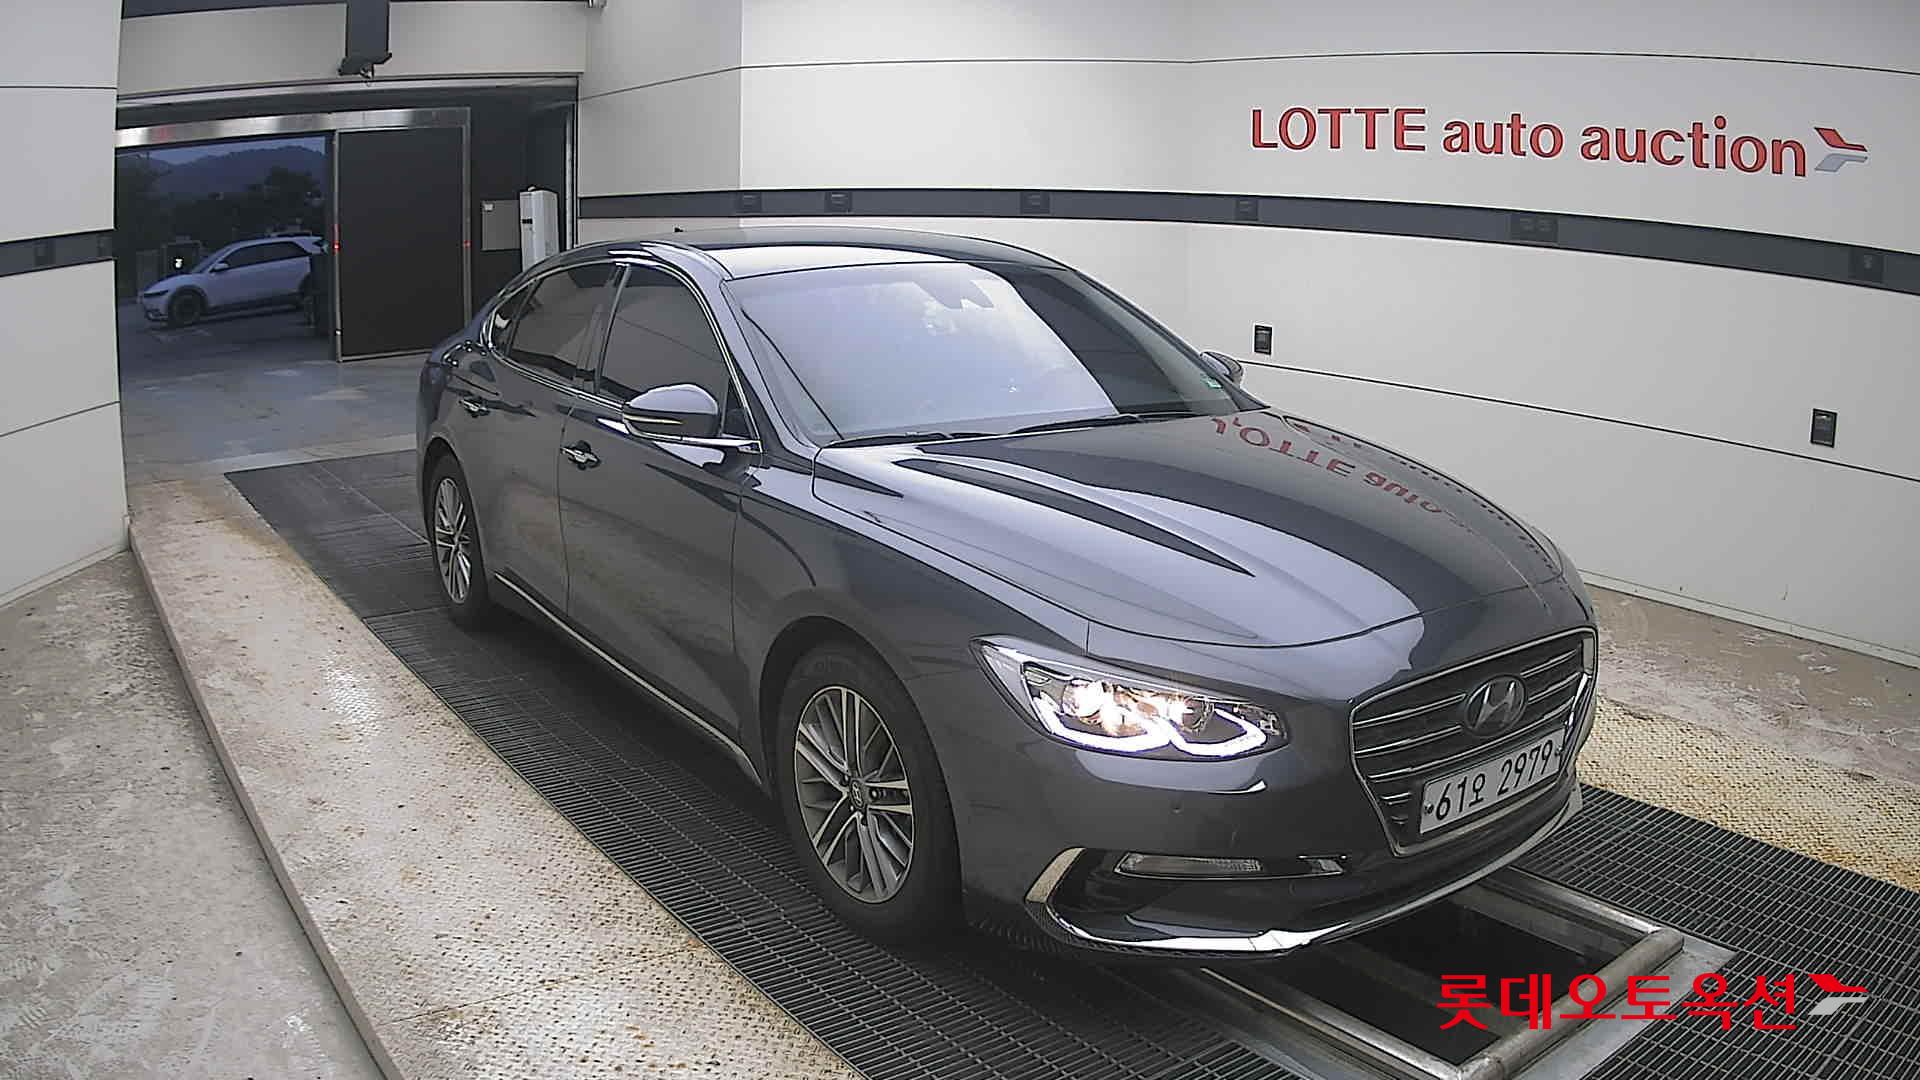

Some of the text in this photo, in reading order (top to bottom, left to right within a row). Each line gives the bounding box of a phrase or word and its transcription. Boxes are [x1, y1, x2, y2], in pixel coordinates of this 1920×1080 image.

[1251, 106, 1808, 178] LOTTE auto auction
[1435, 739, 1554, 821] 61오 2979
